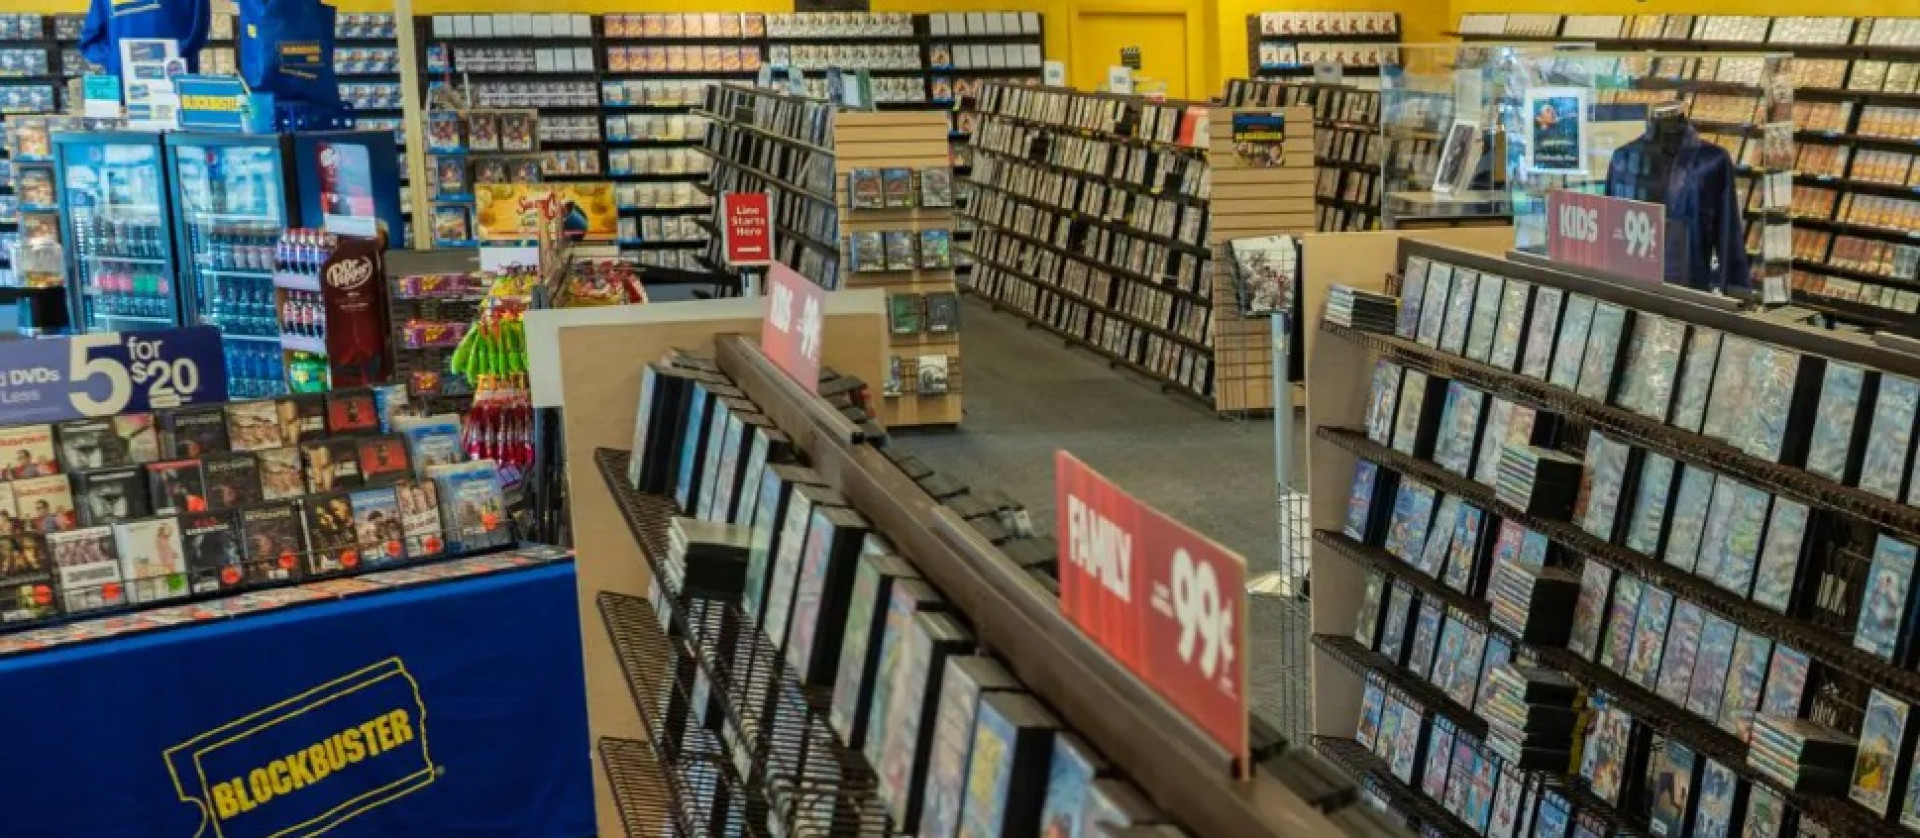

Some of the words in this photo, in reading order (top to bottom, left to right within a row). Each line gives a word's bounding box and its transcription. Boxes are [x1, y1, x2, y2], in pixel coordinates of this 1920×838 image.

[731, 216, 766, 226] Starts
[736, 205, 760, 215] Line
[1560, 203, 1597, 242] KIDS
[736, 227, 762, 237] Here
[10, 367, 61, 385] DVDs
[69, 333, 132, 417] 5
[127, 336, 163, 360] for
[131, 357, 199, 396] $20
[1067, 494, 1131, 604] FAMILY
[211, 708, 413, 820] BLOCKBUSTER
